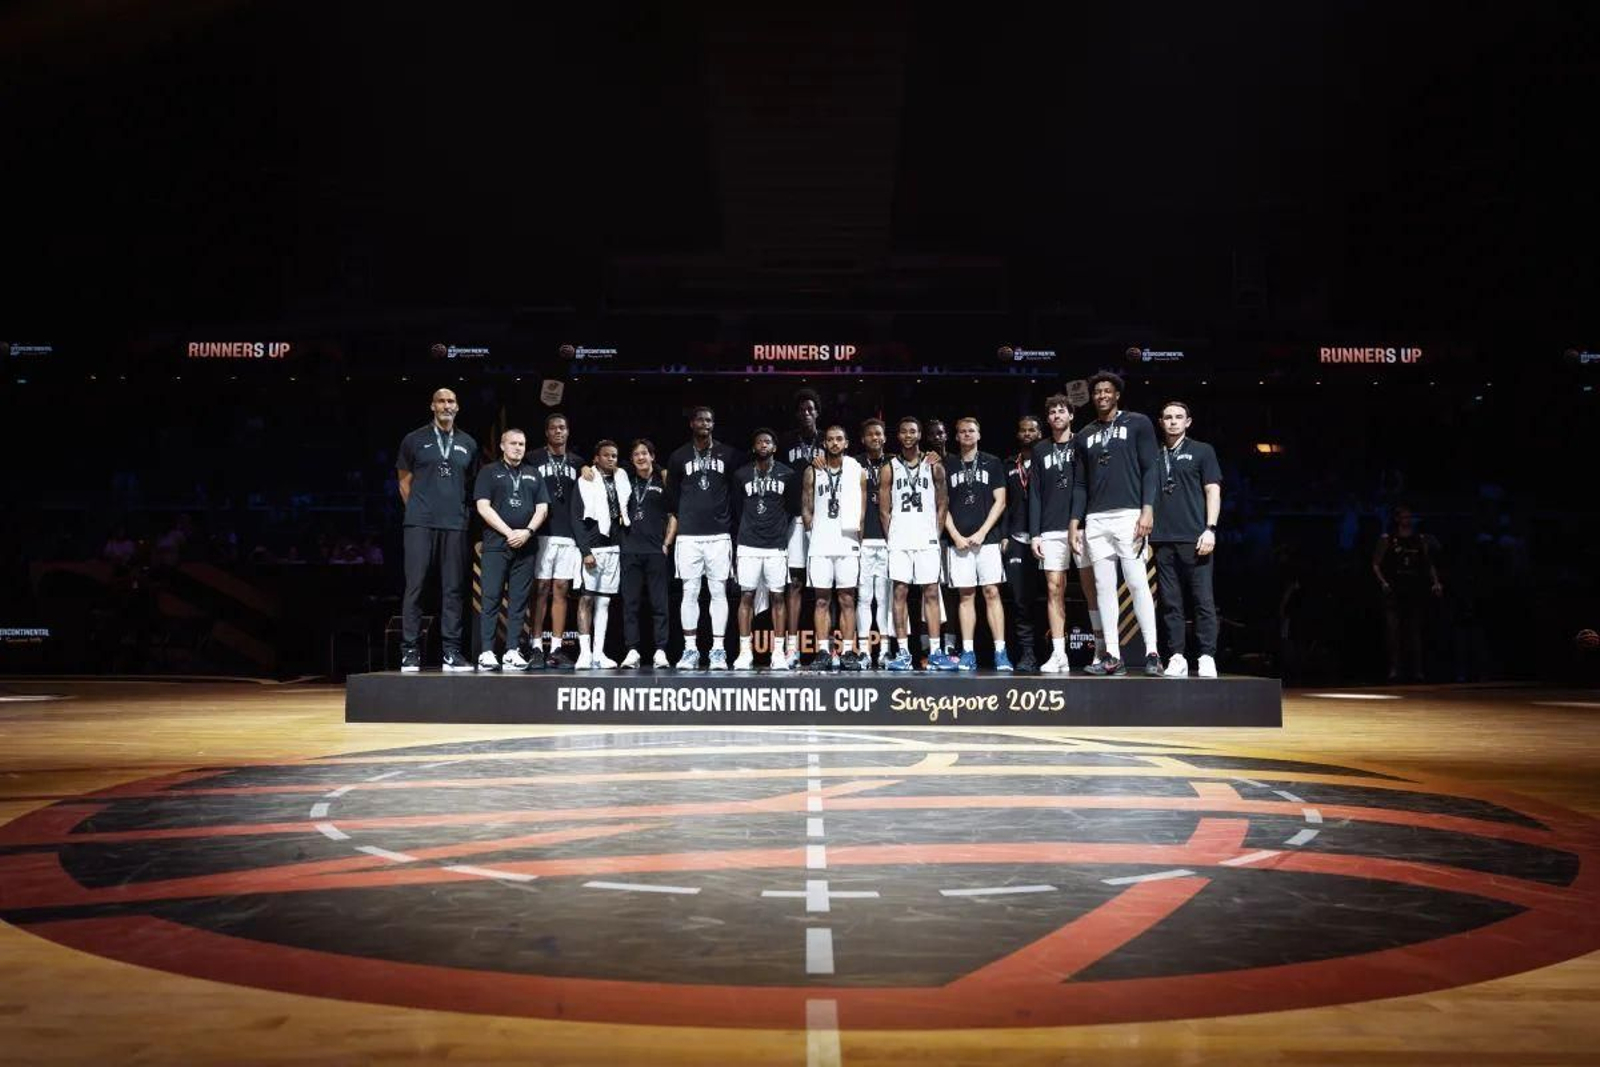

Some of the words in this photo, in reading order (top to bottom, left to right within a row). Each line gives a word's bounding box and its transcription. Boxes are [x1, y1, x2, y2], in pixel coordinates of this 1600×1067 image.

[188, 342, 265, 358] RUNNERS
[268, 342, 291, 358] UP
[753, 344, 830, 361] RUNNERS
[834, 344, 857, 361] UP
[1320, 347, 1397, 364] RUNNERS
[1400, 347, 1423, 364] UP
[556, 687, 606, 712] FIBA
[612, 687, 827, 712] INTERCONTINENTAL
[834, 687, 879, 712] CUP
[889, 687, 1000, 722] Singapore
[1005, 688, 1066, 712] 2025
